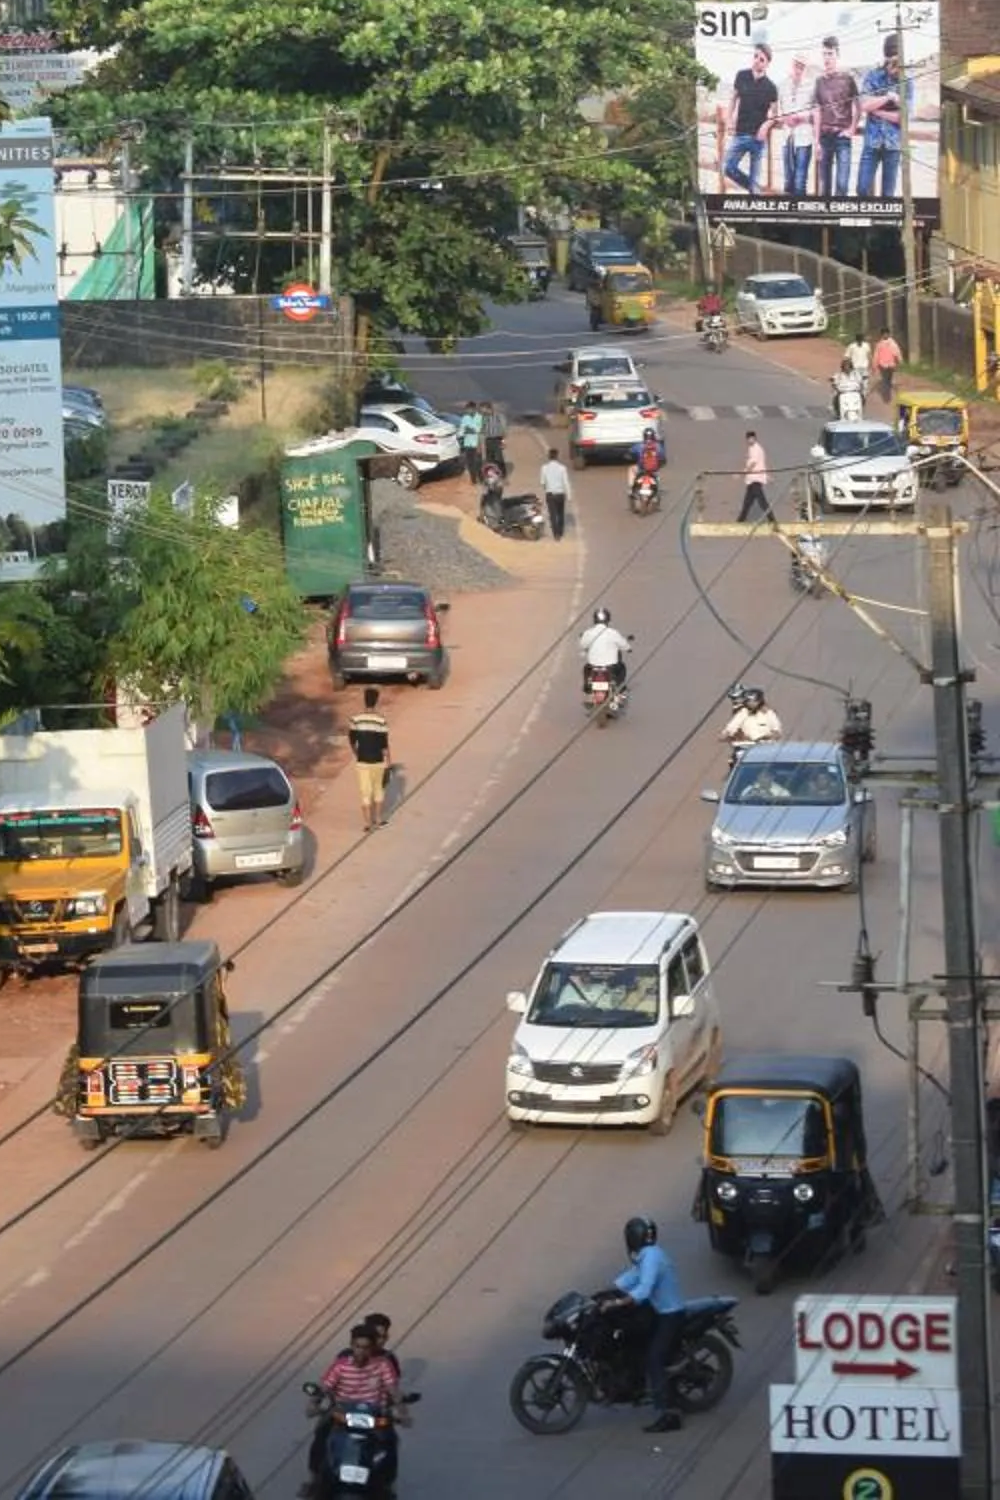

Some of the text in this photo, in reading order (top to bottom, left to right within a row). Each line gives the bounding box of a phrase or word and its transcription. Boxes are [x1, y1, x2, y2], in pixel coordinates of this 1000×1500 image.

[700, 8, 751, 37] sin
[723, 200, 777, 212] AVAILABLE
[860, 202, 903, 213] EXCLUSI
[797, 1311, 952, 1353] LODGE
[782, 1403, 951, 1442] HOTEL
